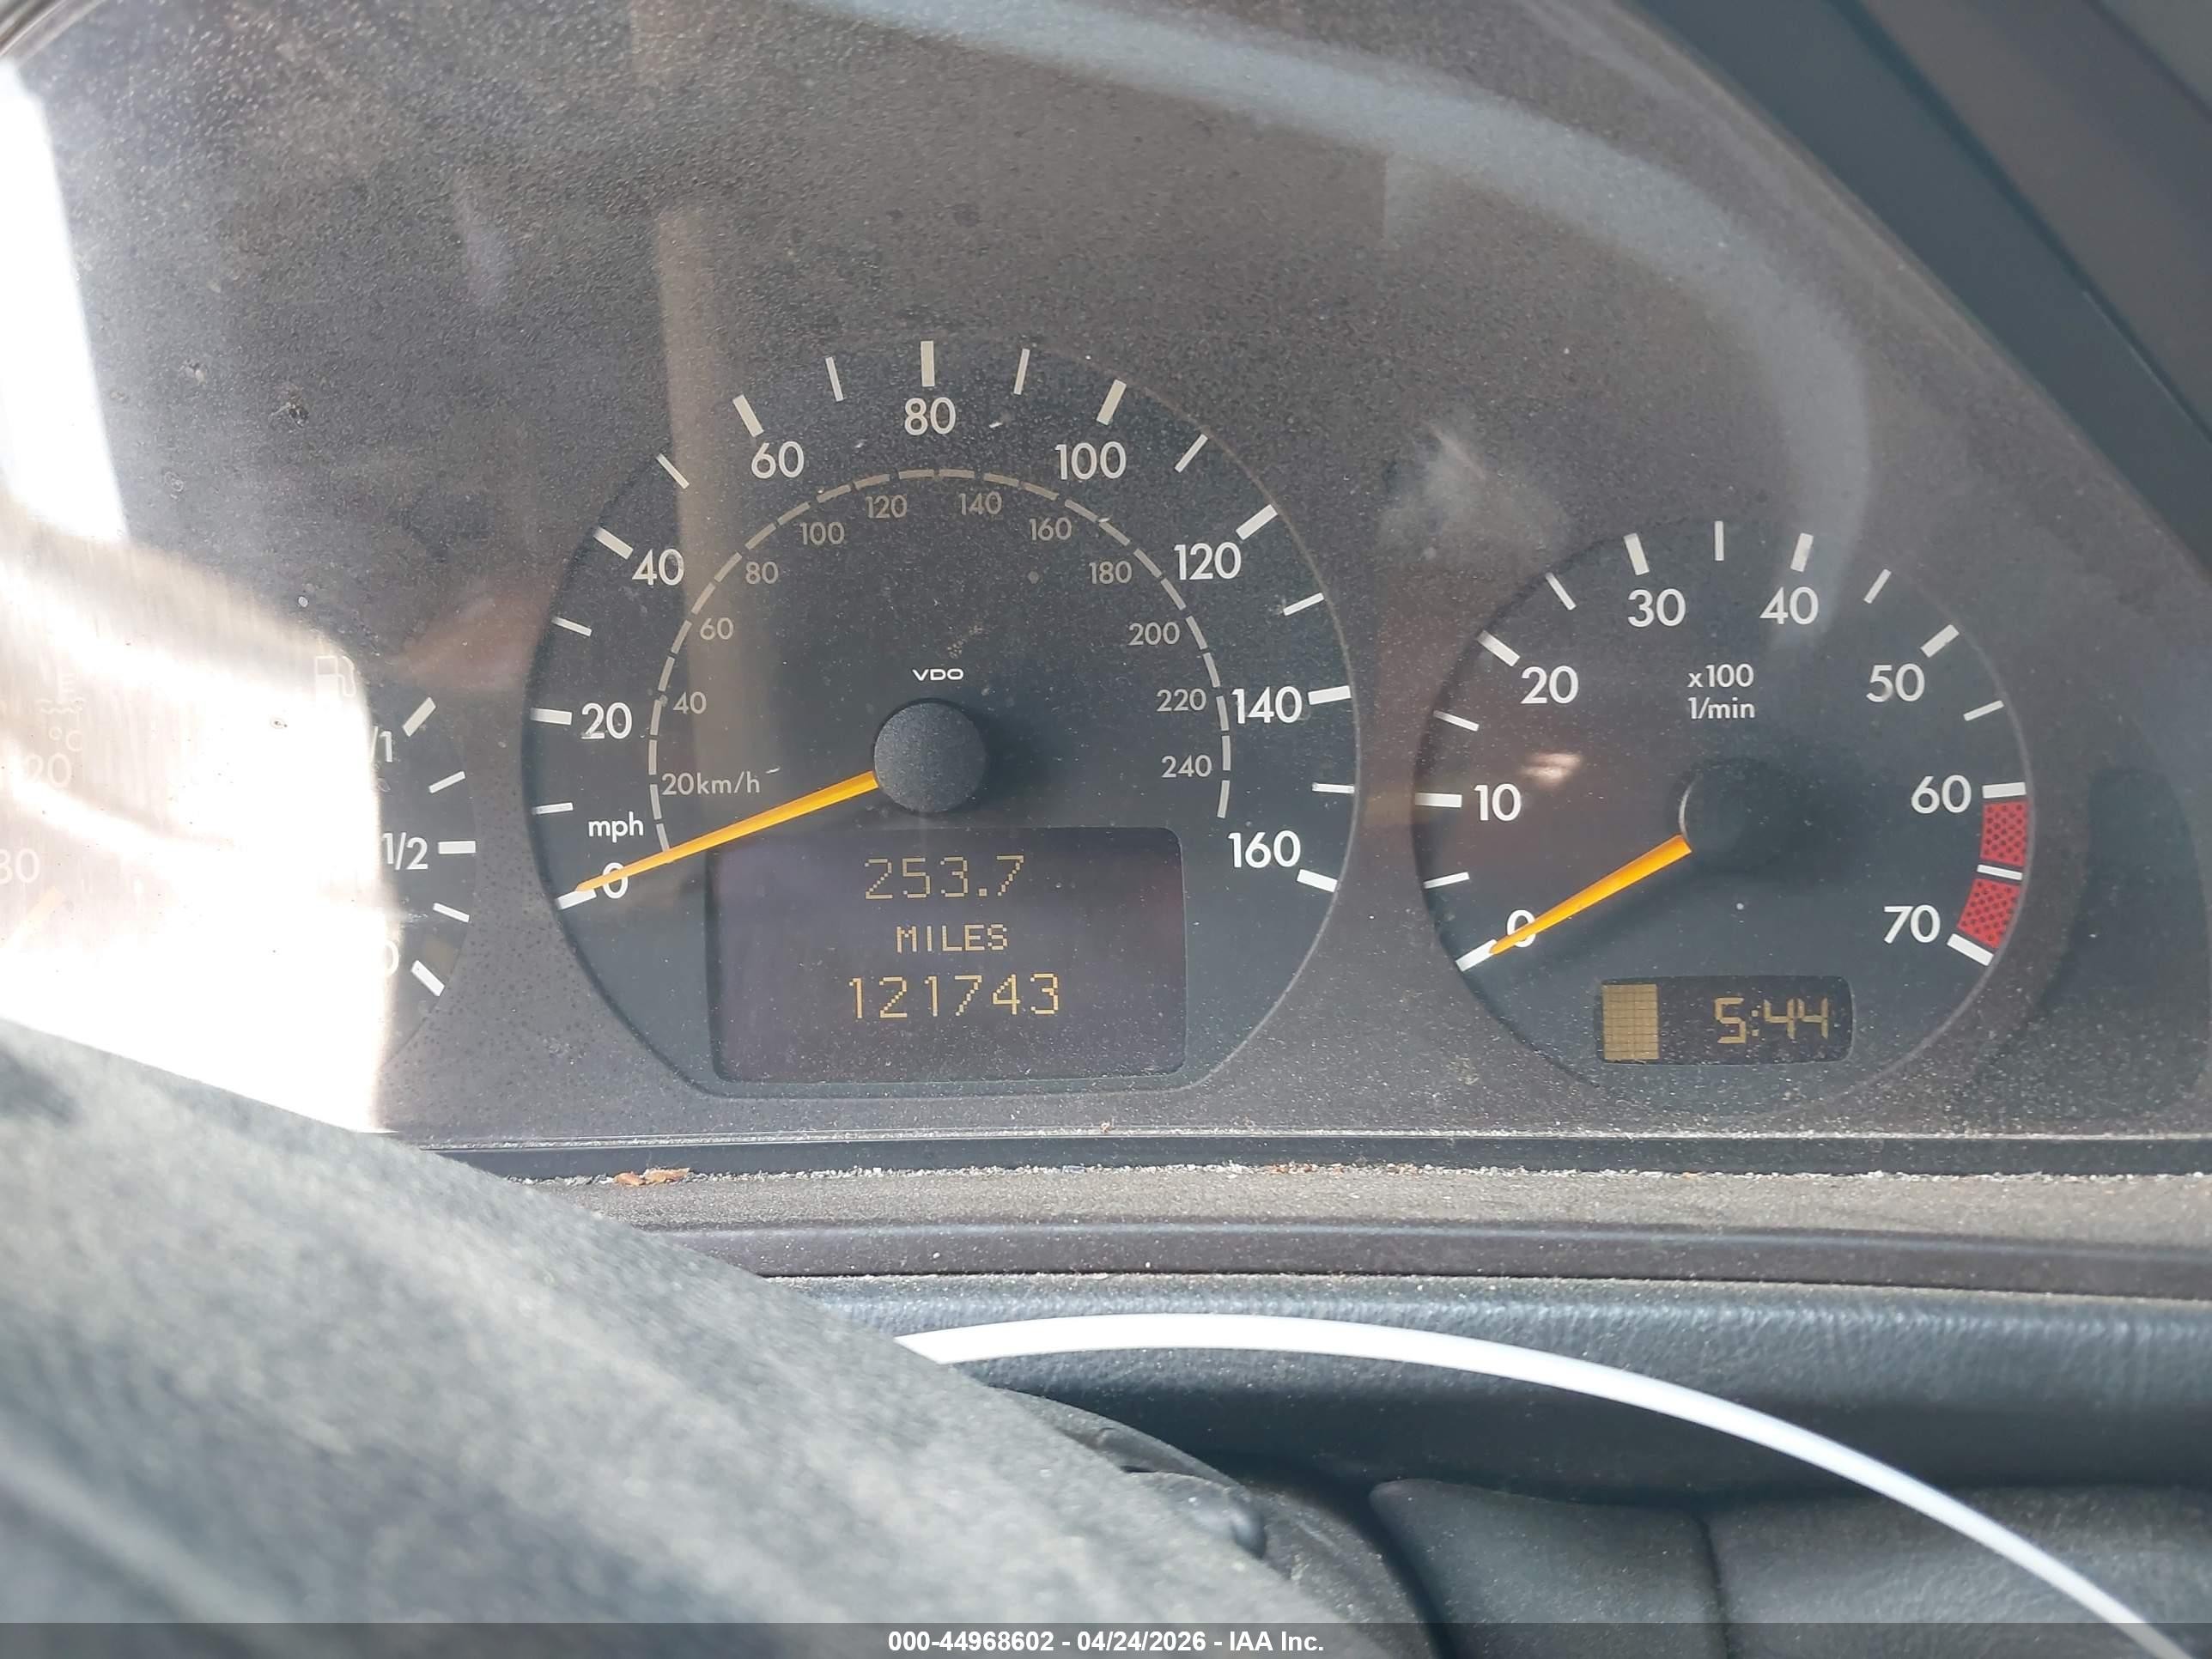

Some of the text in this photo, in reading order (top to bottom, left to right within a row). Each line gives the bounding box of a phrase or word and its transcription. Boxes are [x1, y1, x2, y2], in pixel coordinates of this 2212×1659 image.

[905, 398, 956, 435] 80
[751, 441, 804, 478] 60
[1055, 441, 1126, 479] 100
[866, 495, 907, 518] 120
[959, 491, 1002, 515] 140
[799, 522, 844, 545] 100
[1030, 517, 1072, 540] 160
[632, 549, 684, 585] 40
[745, 562, 778, 584] 80
[1090, 561, 1132, 584] 180
[1175, 542, 1241, 580] 120
[1628, 589, 1686, 627] 30
[1760, 587, 1818, 624] 40
[701, 618, 733, 640] 60
[1129, 623, 1180, 645] 200
[913, 669, 963, 680] VDO
[1522, 666, 1578, 703] 20
[1688, 664, 1753, 687] x100
[1867, 664, 1924, 702] 50
[673, 692, 706, 714] 40
[1158, 689, 1206, 711] 220
[1232, 686, 1302, 723] 140
[1688, 697, 1754, 719] 1/min
[582, 702, 632, 738] 20
[1162, 755, 1212, 777] 240
[1474, 784, 1521, 821] 10
[1911, 775, 1971, 813] 60
[589, 811, 643, 842] mph
[382, 832, 428, 870] 1/2
[1229, 830, 1300, 868] 160
[602, 863, 629, 898] 0
[865, 855, 1024, 899] 253.7
[897, 925, 1007, 952] MILES
[1507, 910, 1536, 947] 0
[1885, 905, 1940, 943] 70
[849, 974, 1058, 1018] 121743
[1715, 998, 1827, 1043] 5:44
